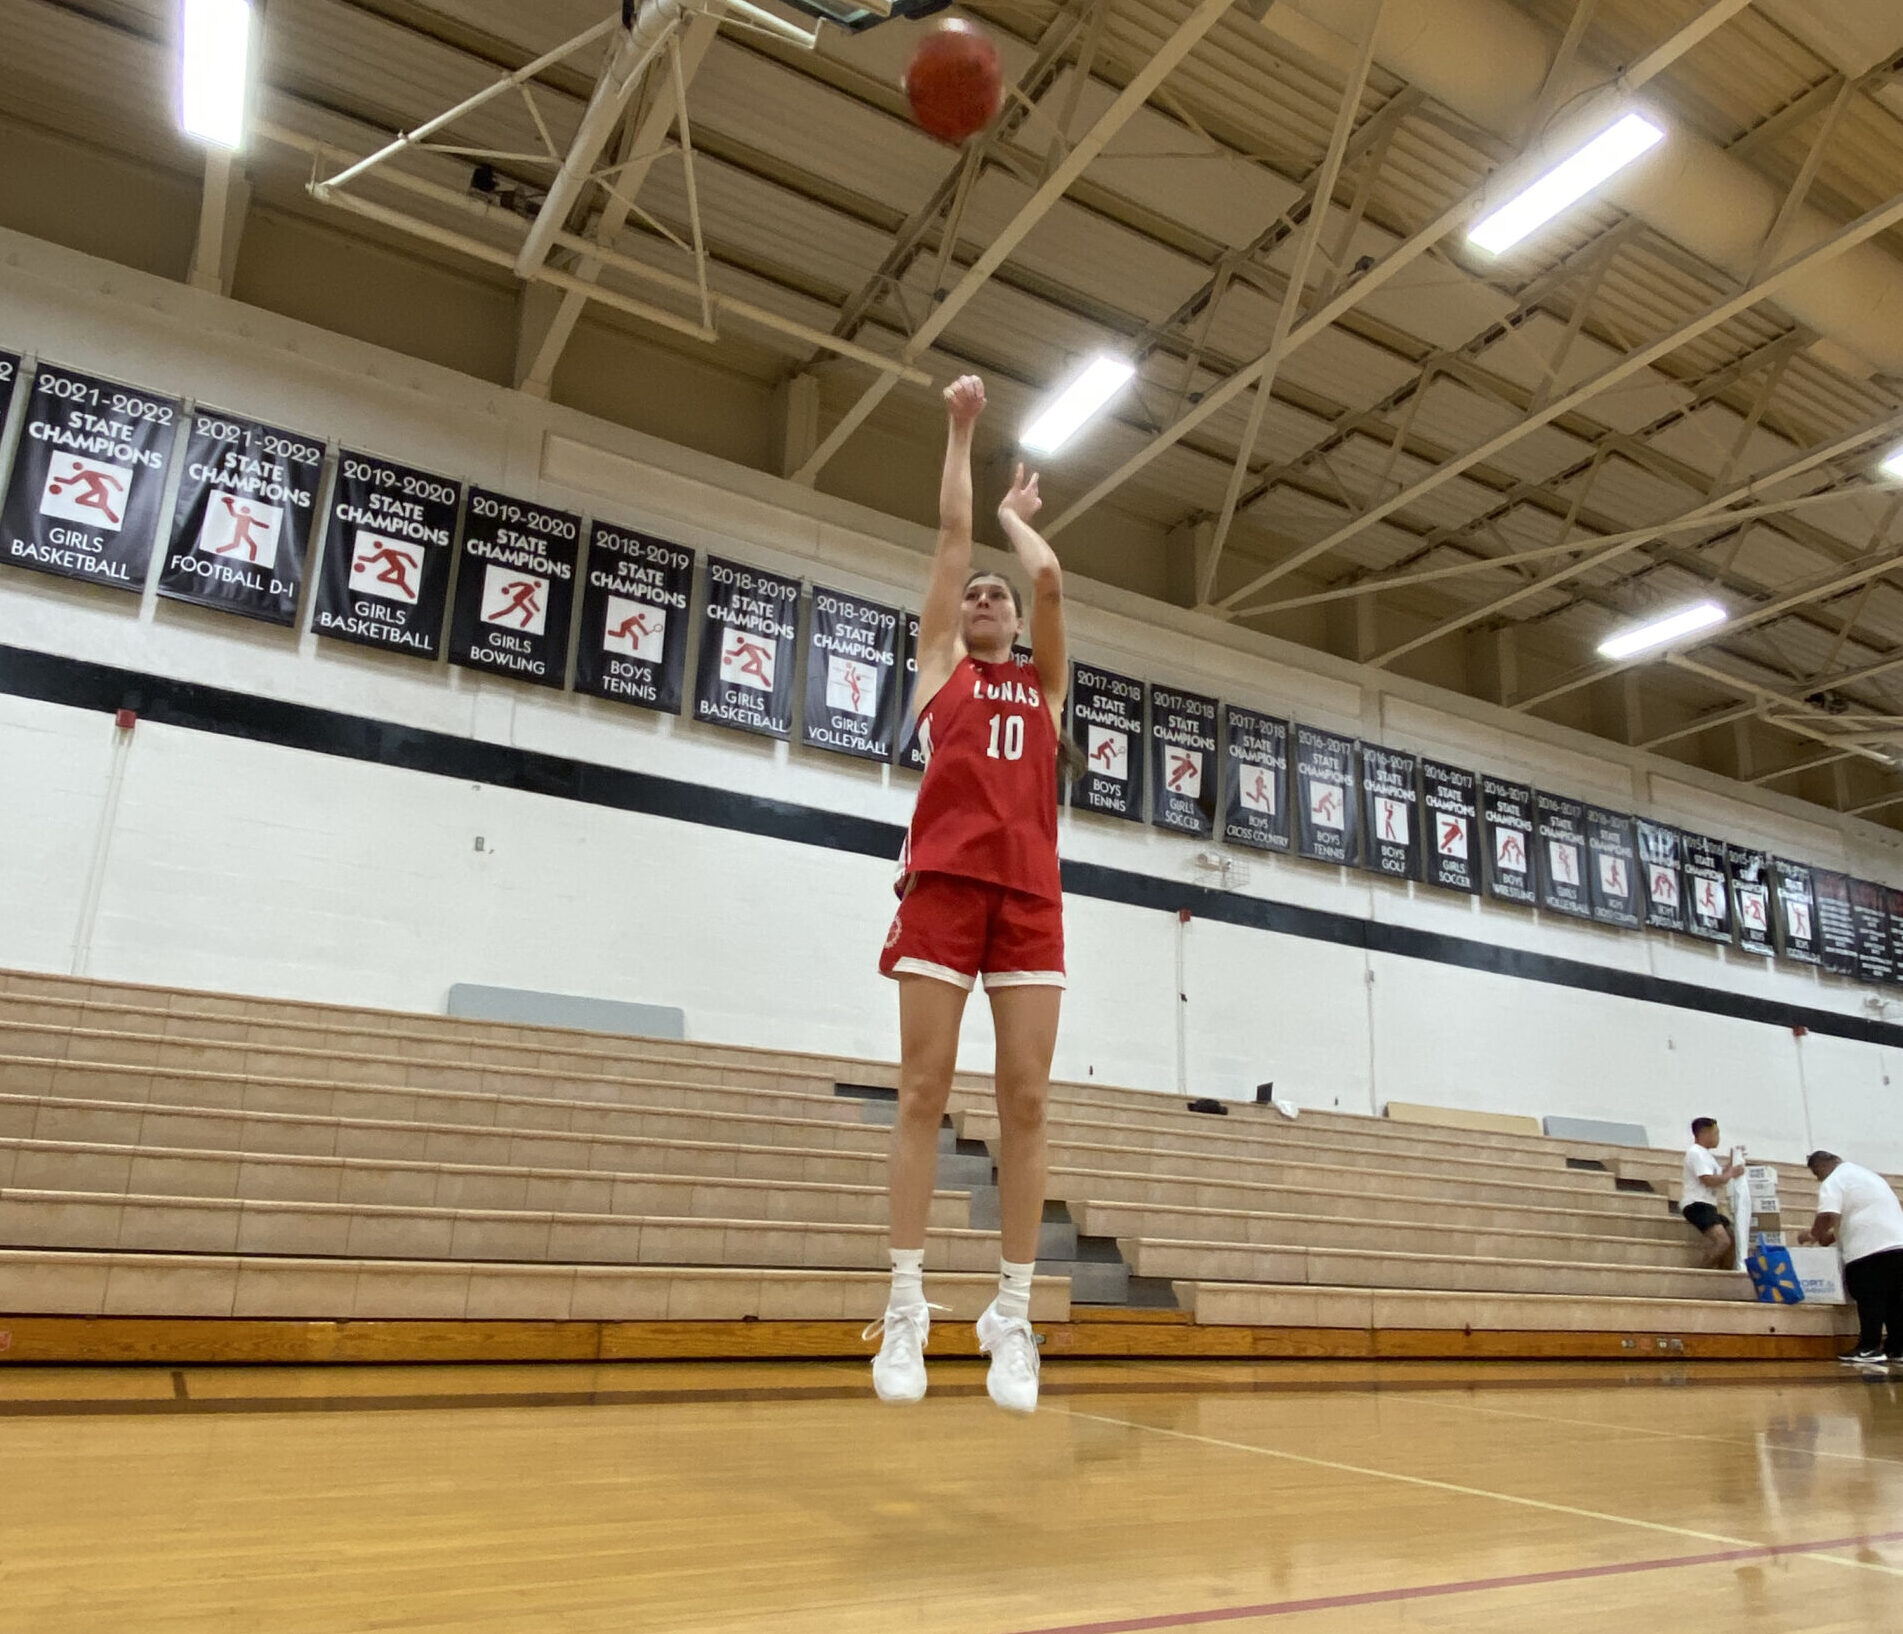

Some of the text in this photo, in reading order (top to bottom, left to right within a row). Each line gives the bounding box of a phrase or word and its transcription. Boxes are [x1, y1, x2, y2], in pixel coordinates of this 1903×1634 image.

[38, 374, 173, 426] 2021-2022
[68, 411, 134, 441] STATE
[28, 421, 163, 469] CHAMPIONS
[196, 418, 320, 466] 2021-2022
[224, 452, 284, 482] STATE
[188, 463, 311, 508] CHAMPIONS
[343, 460, 455, 505] 2019-2020
[369, 493, 424, 521] STATE
[472, 496, 576, 540] 2019-2020
[336, 504, 450, 547] CHAMPIONS
[49, 527, 104, 553] GIRLS
[497, 529, 547, 556] STATE
[596, 530, 690, 570] 2018-2019
[11, 539, 130, 580] BASKETBALL
[466, 539, 572, 580] CHAMPIONS
[170, 555, 264, 591] FOOTBALL
[618, 561, 664, 587] STATE
[711, 565, 797, 602] 2018-2019
[590, 571, 686, 609] CHAMPIONS
[354, 601, 406, 625] GIRLS
[731, 594, 774, 619] STATE
[817, 595, 896, 630] 2018-2019
[320, 612, 433, 651] BASKETBALL
[706, 604, 795, 640] CHAMPIONS
[835, 623, 876, 646] STATE
[488, 632, 532, 654] GIRLS
[813, 633, 894, 667] CHAMPIONS
[470, 646, 545, 675] BOWLING
[610, 660, 652, 682] BOYS
[602, 675, 657, 701] TENNIS
[974, 680, 1040, 707] LUNAS
[1077, 670, 1141, 701] 2017-2018
[725, 690, 765, 712] GIRLS
[1093, 695, 1126, 715] STATE
[1154, 691, 1215, 720] 2017-2018
[700, 700, 789, 733] BASKETBALL
[831, 715, 868, 736] GIRLS
[1075, 704, 1141, 733] CHAMPIONS
[1168, 715, 1199, 734] STATE
[1228, 711, 1286, 739] 2017-2018
[808, 726, 889, 757] VOLLEYBALL
[987, 714, 1024, 761] 10
[1153, 725, 1215, 751] CHAMPIONS
[1243, 735, 1272, 753] STATE
[1298, 730, 1351, 755] 2016-2017
[1229, 745, 1286, 770] CHAMPIONS
[1313, 753, 1339, 770] STATE
[1363, 748, 1414, 772] 2016-2017
[1299, 762, 1353, 787] CHAMPIONS
[1376, 769, 1403, 786] STATE
[1424, 764, 1473, 788] 2016-2017
[1093, 779, 1121, 796] BOYS
[1363, 779, 1416, 801] CHAMPIONS
[1437, 785, 1462, 802] STATE
[1089, 792, 1126, 812] TENNIS
[1169, 798, 1195, 815] GIRLS
[1425, 795, 1475, 817] CHAMPIONS
[1497, 800, 1520, 816] STATE
[1165, 810, 1200, 831] SOCCER
[1248, 815, 1269, 829] BOYS
[1485, 810, 1532, 832] CHAMPIONS
[1226, 825, 1289, 847] CROSS COUNTRY
[1317, 830, 1340, 846] BOYS
[1314, 843, 1345, 860] TENNIS
[1381, 845, 1405, 860] BOYS
[1382, 858, 1406, 873] GOLF
[1443, 860, 1466, 874] GIRLS
[1439, 870, 1471, 887] SOCCER
